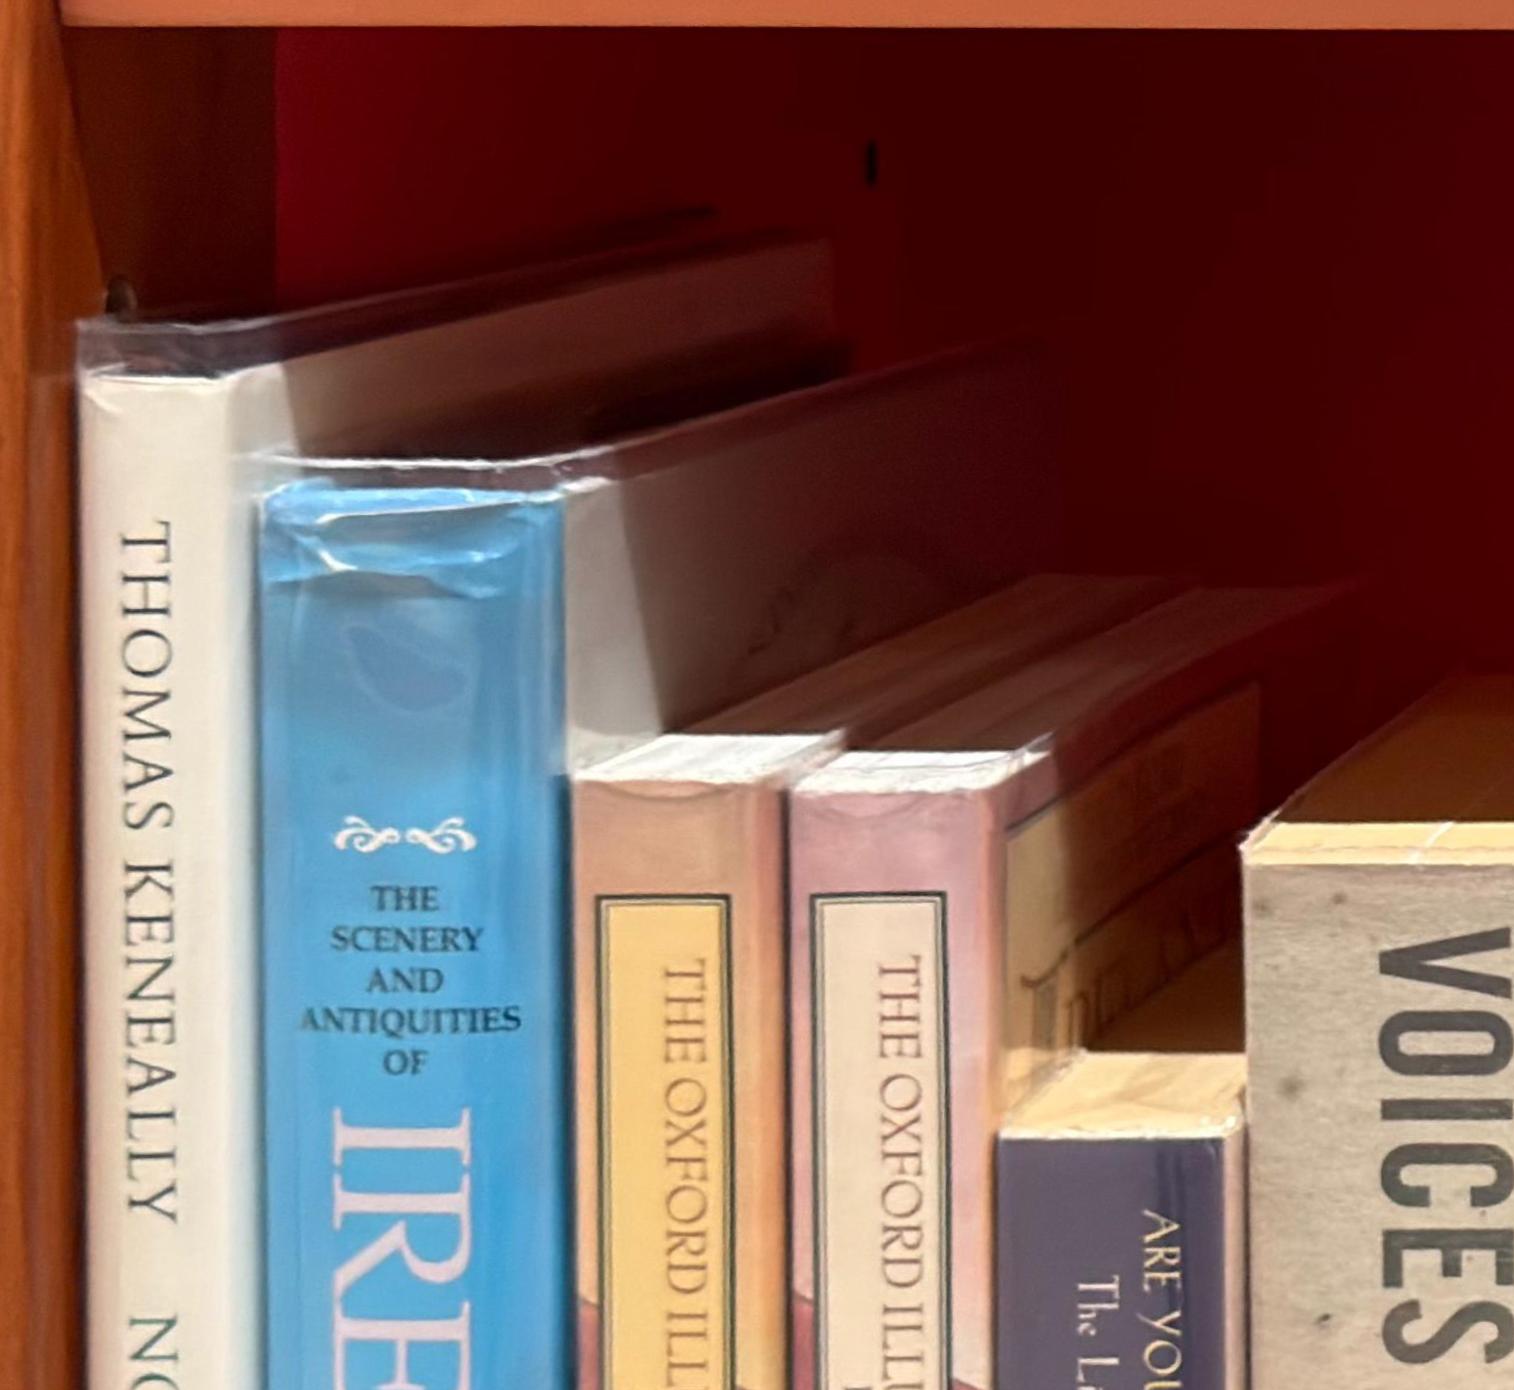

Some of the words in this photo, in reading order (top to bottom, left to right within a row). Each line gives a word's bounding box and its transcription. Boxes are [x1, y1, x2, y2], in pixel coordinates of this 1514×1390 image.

[121, 520, 172, 831] THOMAS
[330, 925, 484, 954] SCENERY
[371, 885, 439, 912] THE
[300, 1006, 522, 1034] ANTIQUITIES
[365, 967, 444, 994] AND
[663, 958, 704, 1063] THE
[878, 955, 921, 1059] THE
[125, 858, 178, 1223] KENEALLY
[382, 1049, 427, 1076] OF
[664, 1078, 708, 1296] OXFORD
[879, 1073, 924, 1290] OXFORD
[1140, 1208, 1181, 1292] ARE
[1075, 1275, 1121, 1337] The
